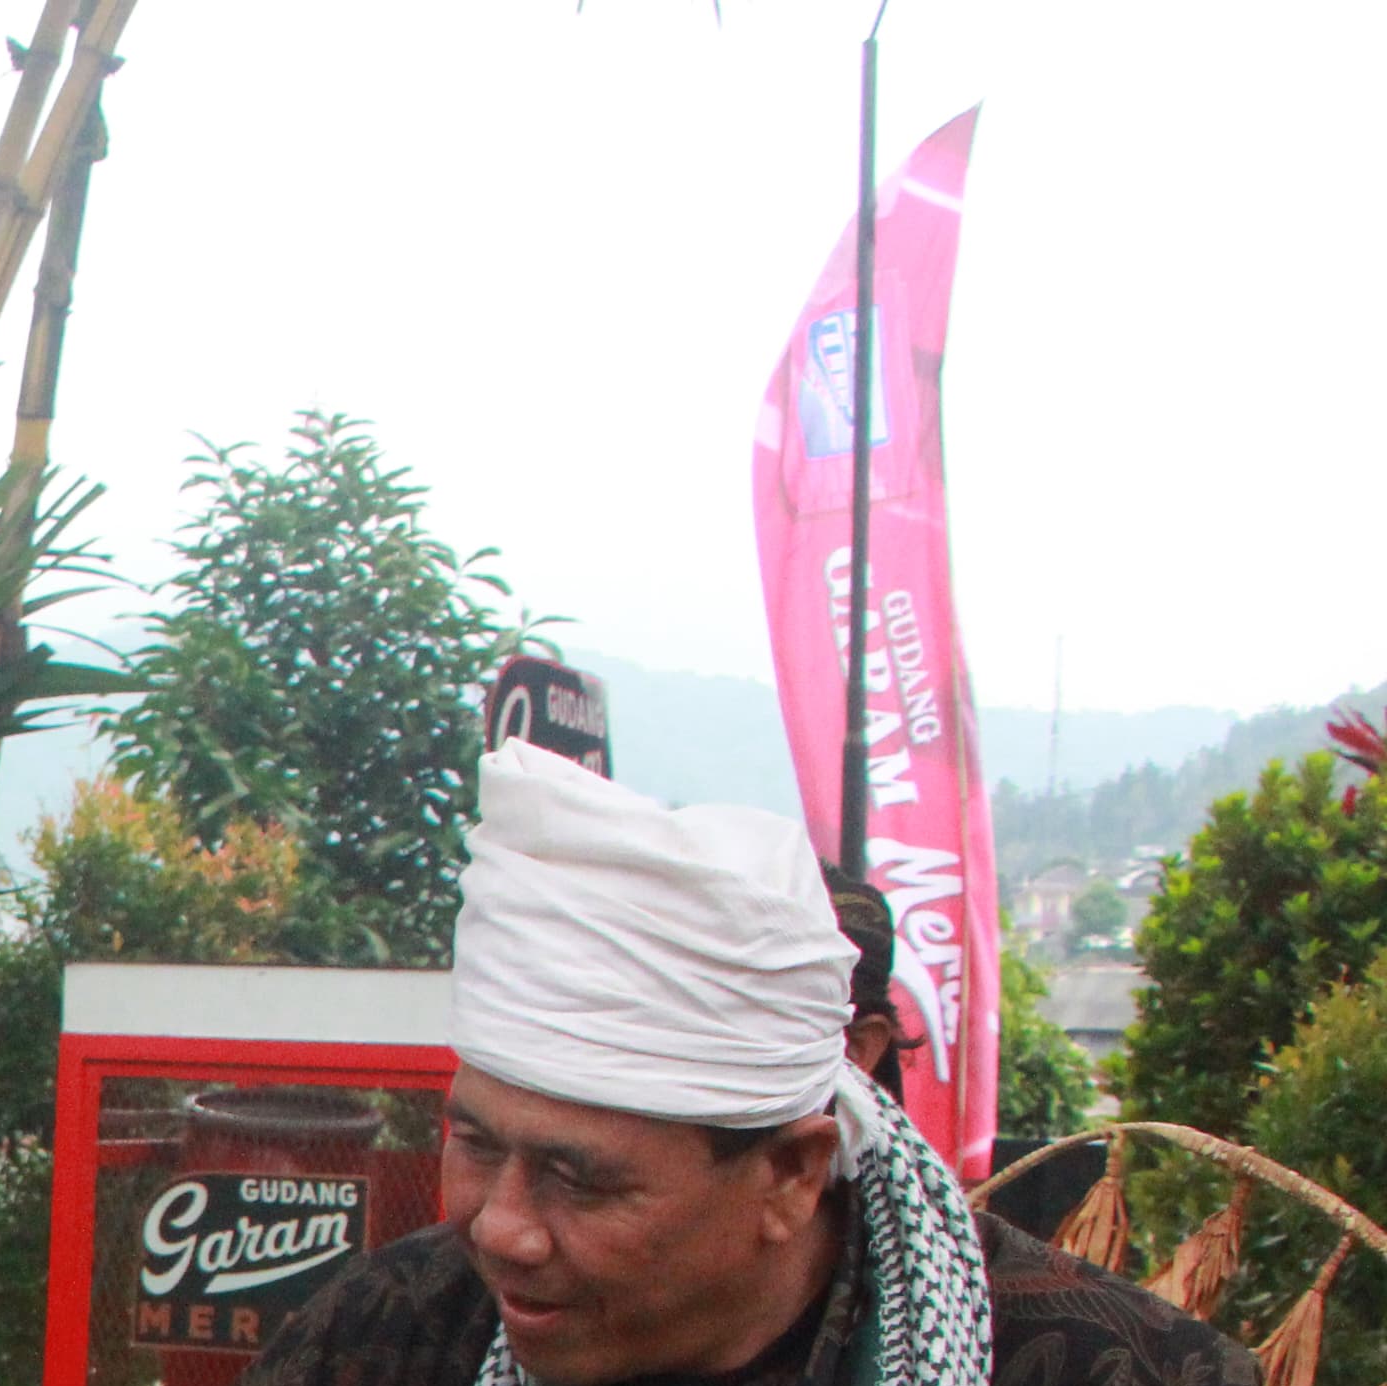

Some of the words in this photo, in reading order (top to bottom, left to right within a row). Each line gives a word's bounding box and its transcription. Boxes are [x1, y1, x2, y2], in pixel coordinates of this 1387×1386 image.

[882, 590, 941, 745] GUDANG
[239, 1178, 358, 1208] GUDANG
[140, 1181, 351, 1295] Garam
[138, 1302, 301, 1343] MER
